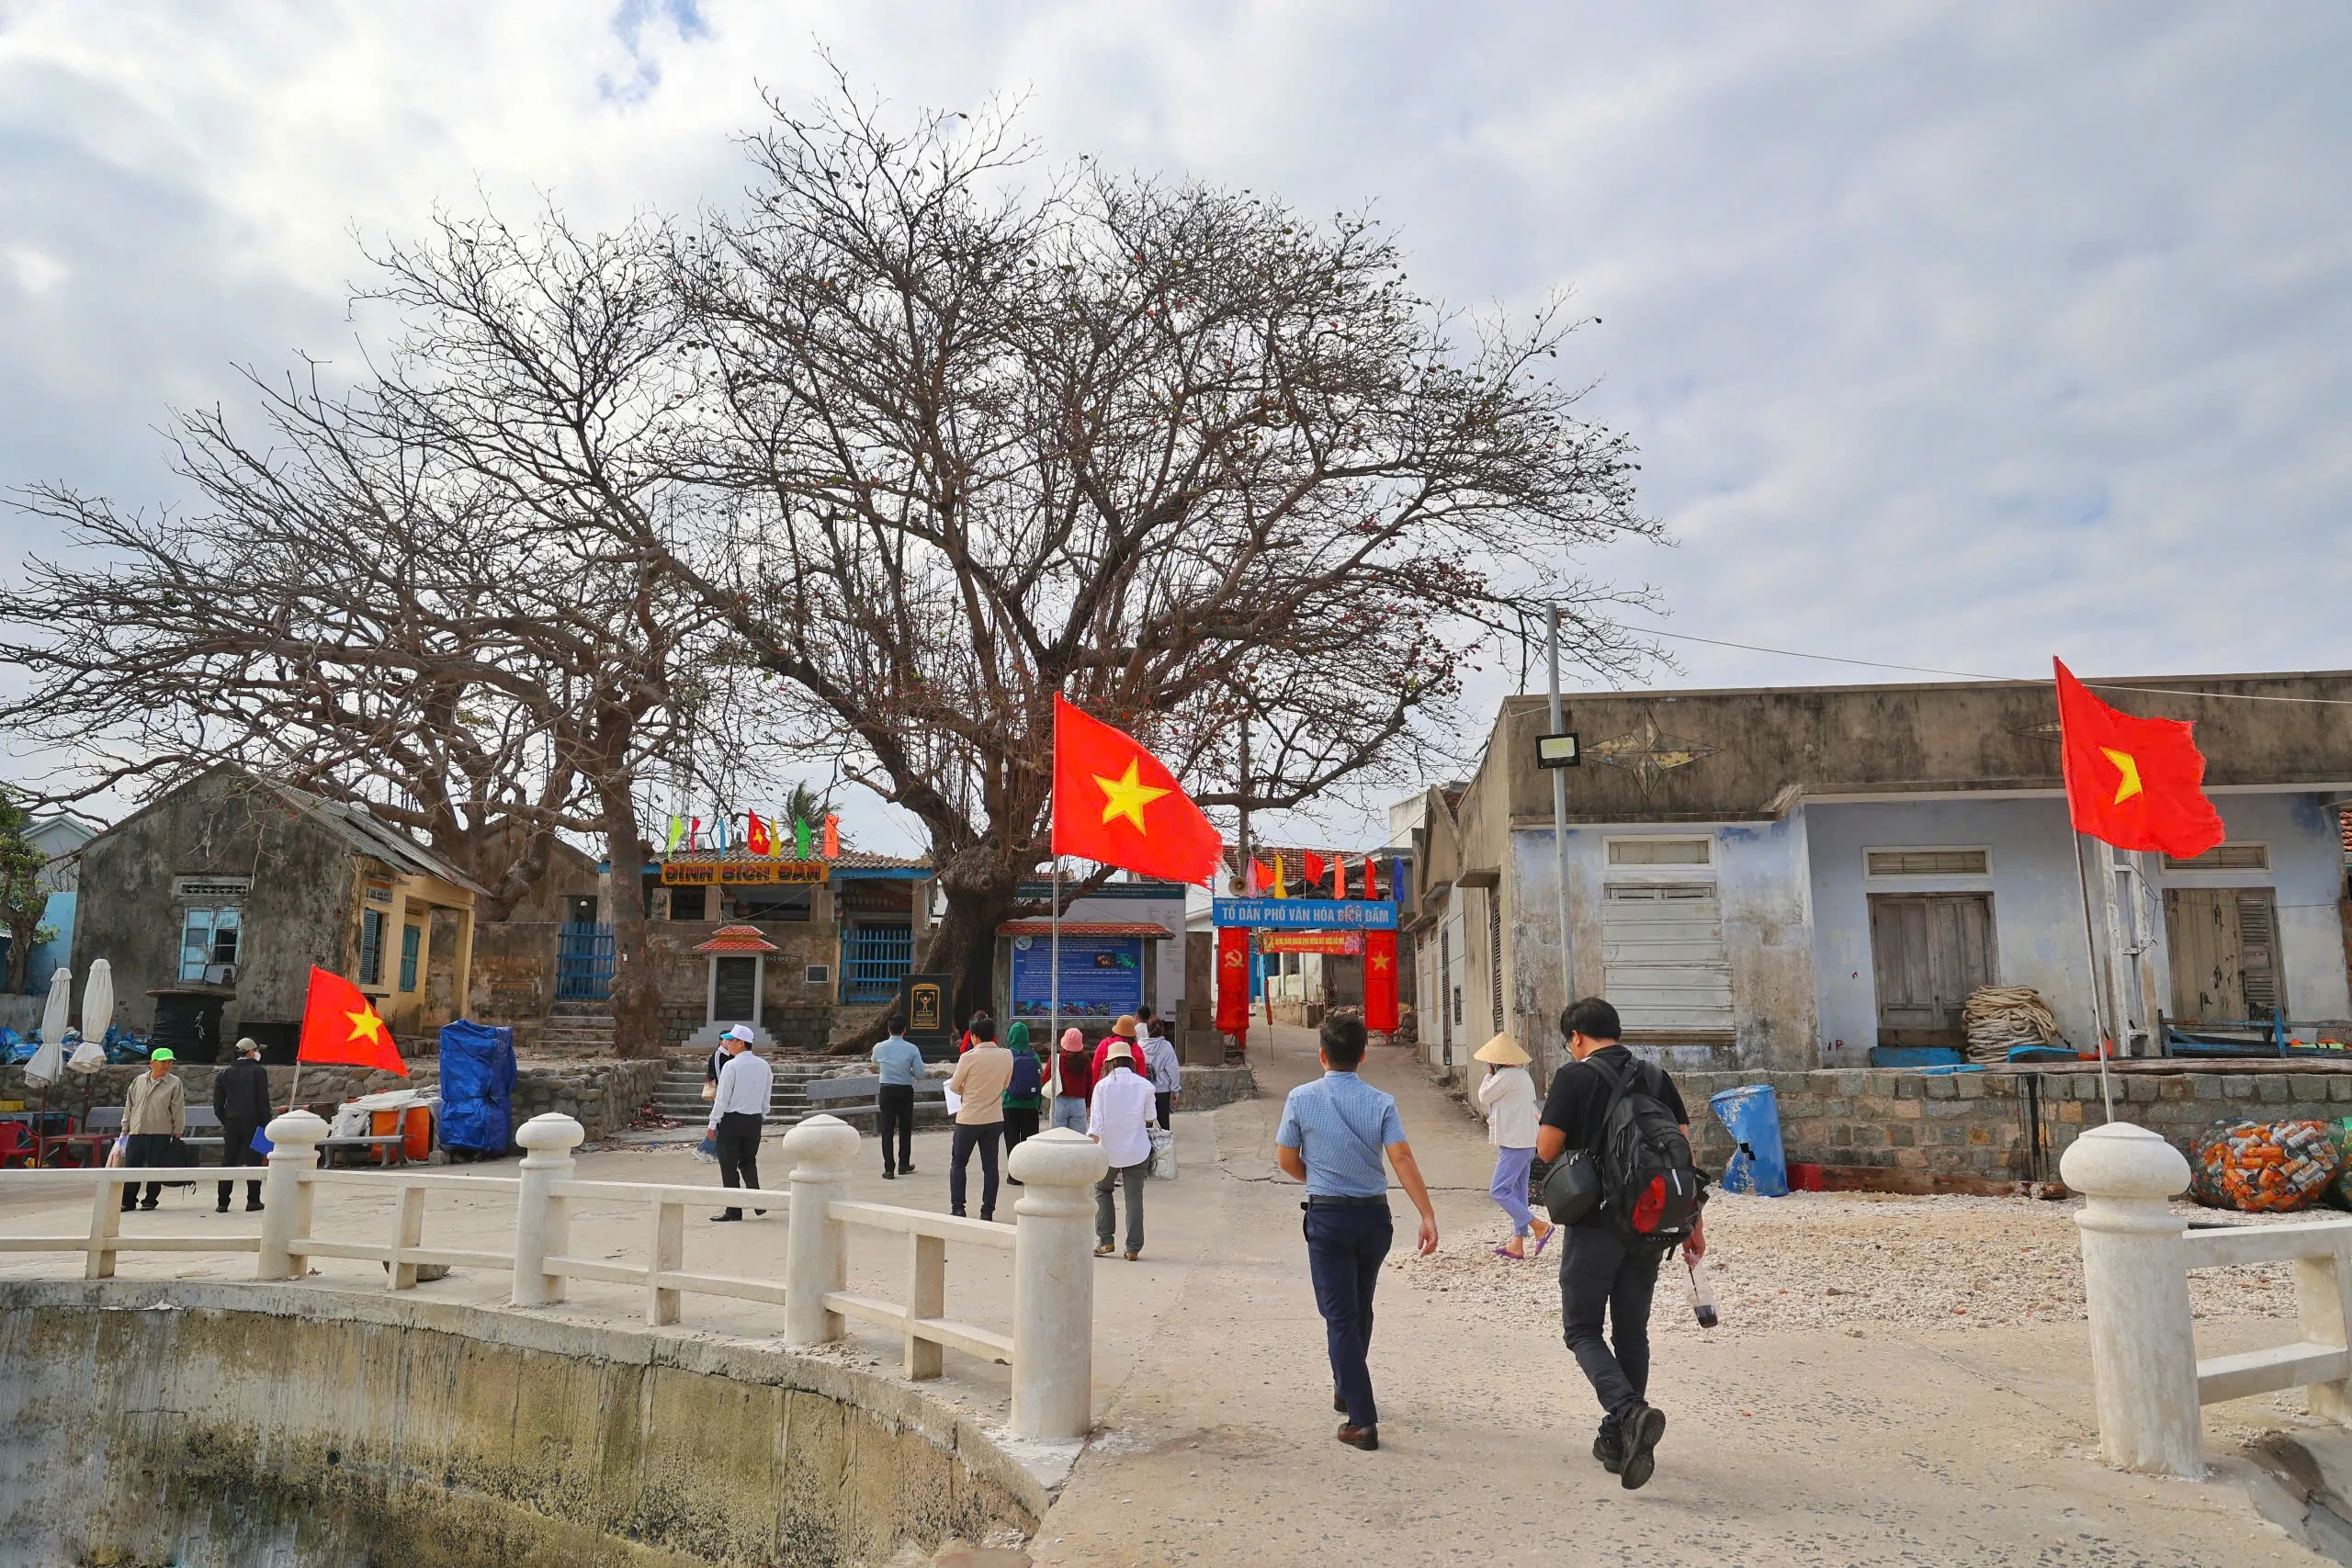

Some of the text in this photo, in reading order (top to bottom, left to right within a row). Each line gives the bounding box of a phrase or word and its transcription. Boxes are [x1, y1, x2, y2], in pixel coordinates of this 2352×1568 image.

[1238, 905, 1261, 920] DÂN
[1263, 905, 1286, 921] PHỐ
[1288, 906, 1310, 921] VĂN
[1313, 906, 1334, 921] HÓA
